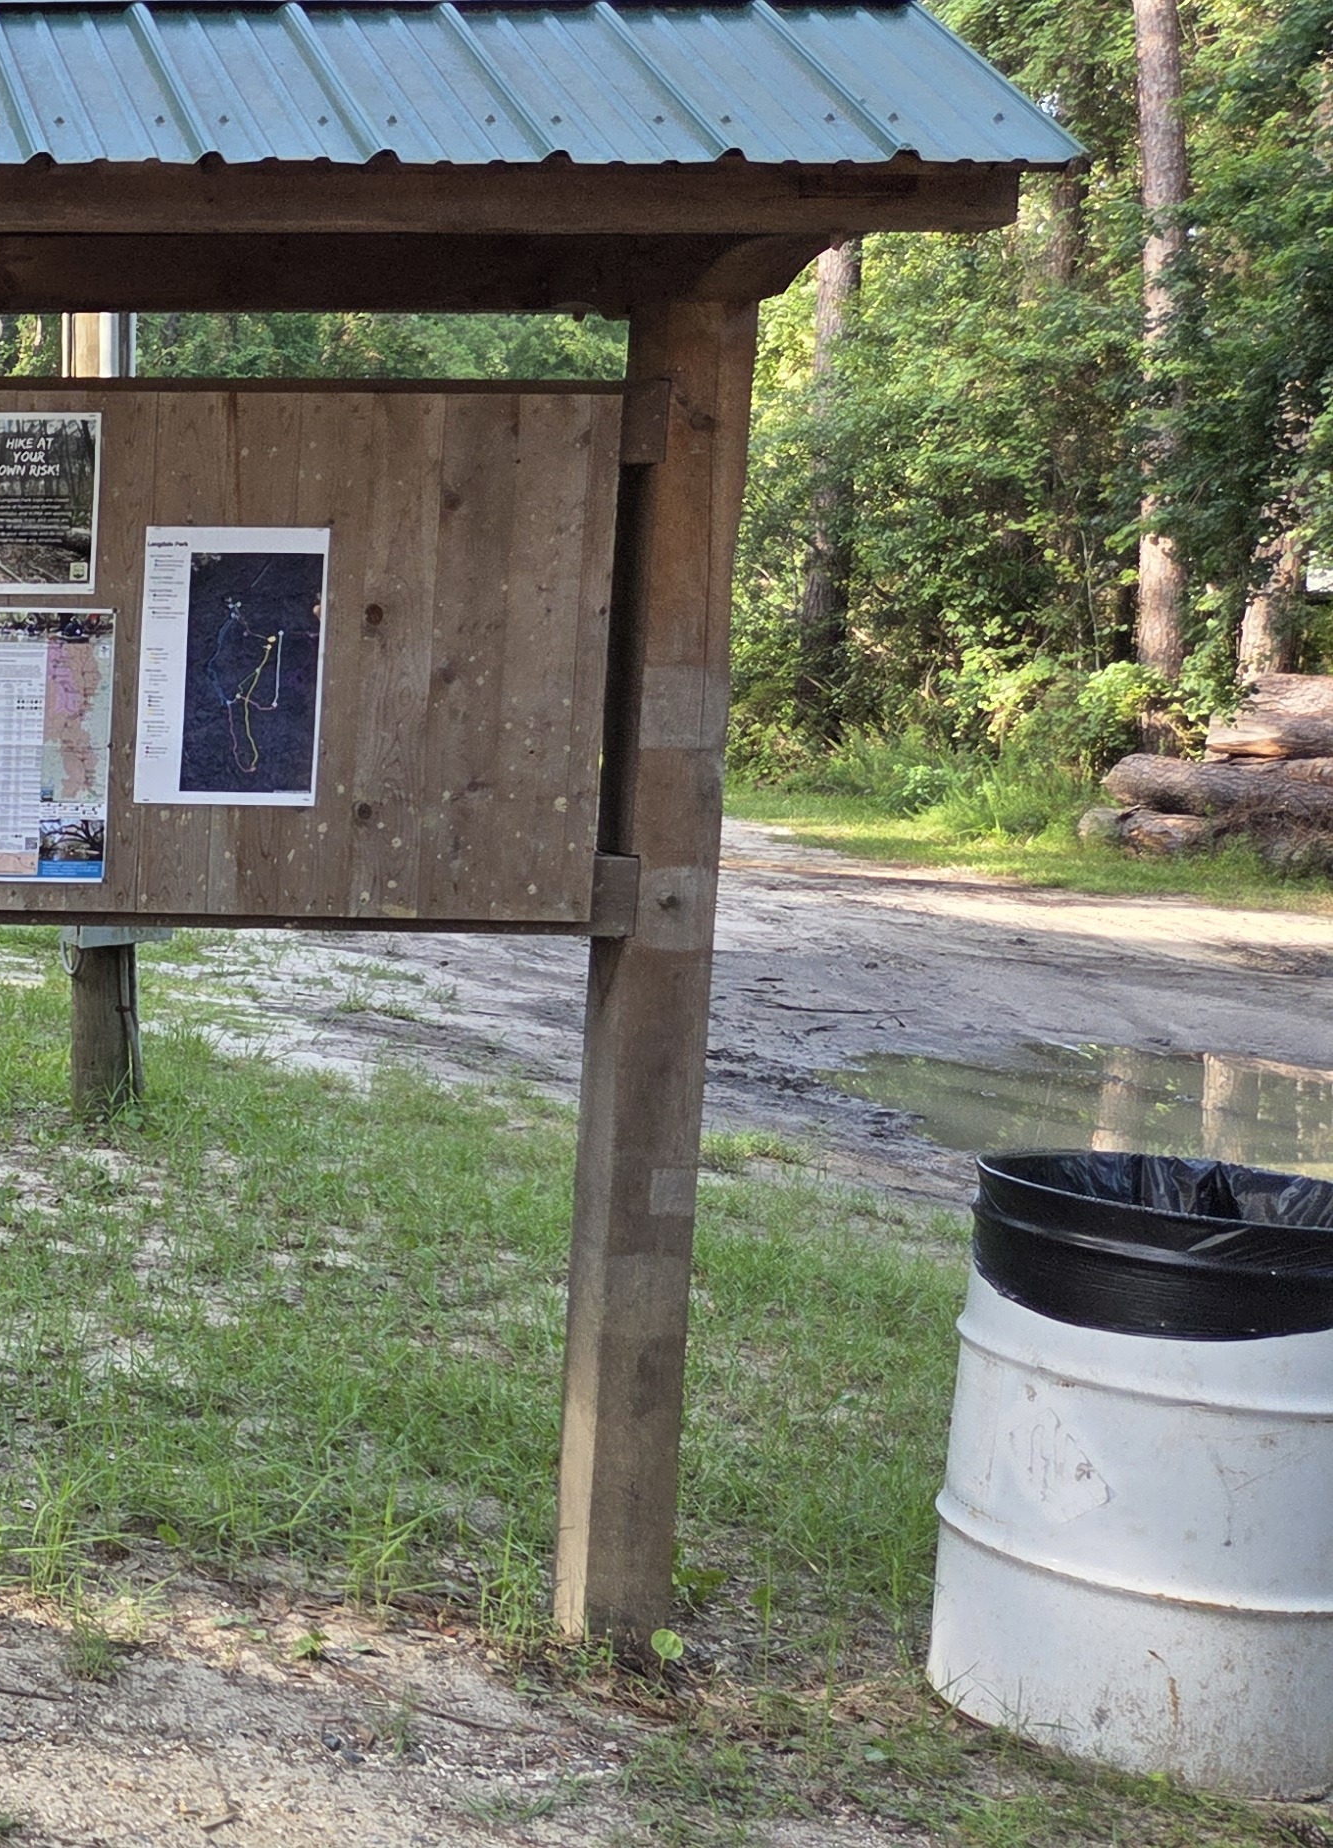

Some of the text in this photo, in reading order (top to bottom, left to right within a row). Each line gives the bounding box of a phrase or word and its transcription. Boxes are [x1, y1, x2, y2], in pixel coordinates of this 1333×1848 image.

[6, 438, 54, 449] HIKE AT
[12, 452, 45, 463] YOUR
[29, 464, 60, 476] RISK!
